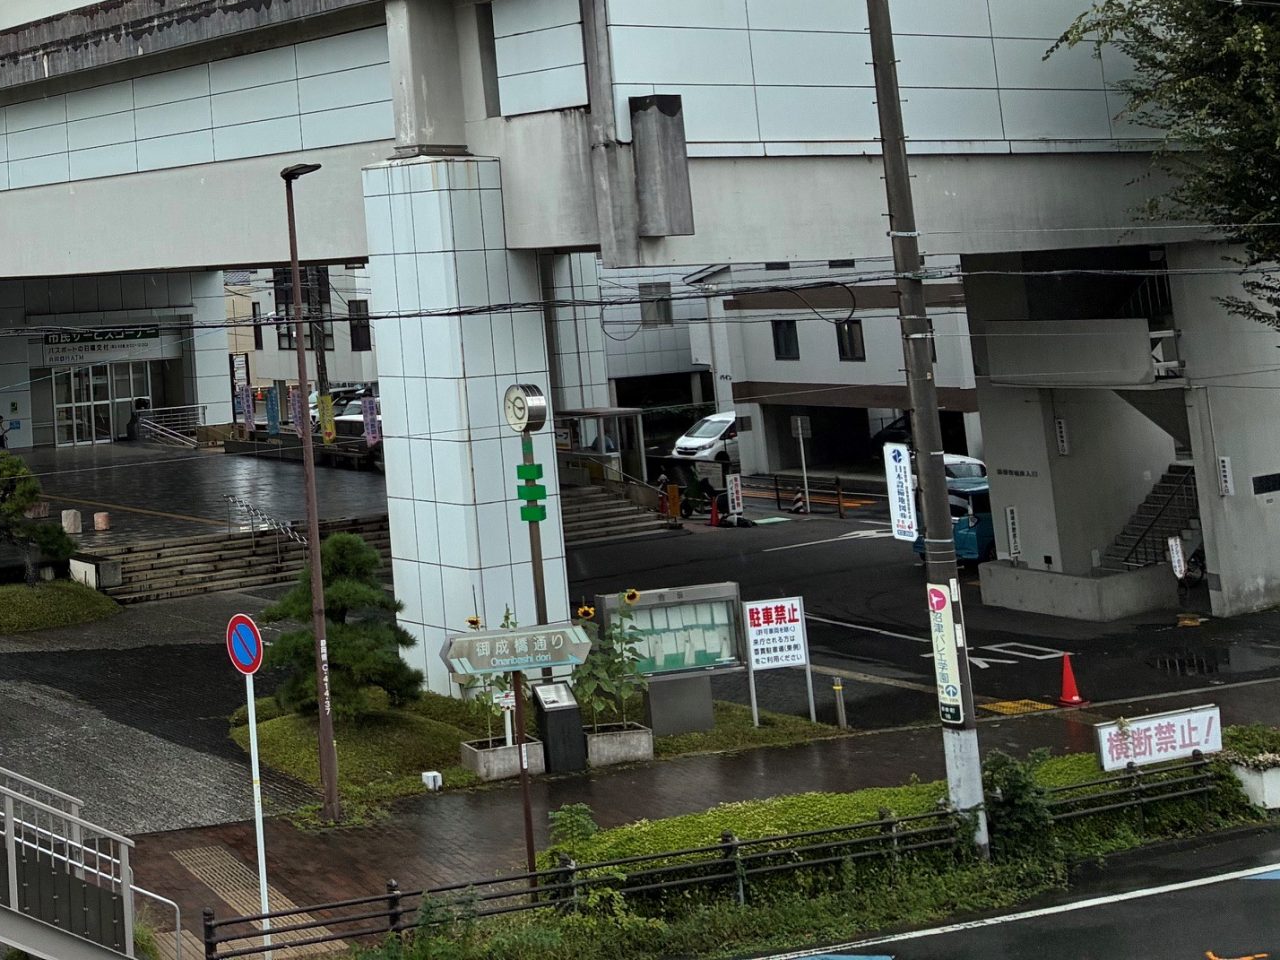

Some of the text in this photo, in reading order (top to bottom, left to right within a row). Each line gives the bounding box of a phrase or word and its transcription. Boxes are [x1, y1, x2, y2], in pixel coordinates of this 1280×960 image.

[749, 603, 800, 628] 駐車禁止
[475, 634, 563, 657] 御成橋通り
[1107, 716, 1214, 761] 横断禁止!
